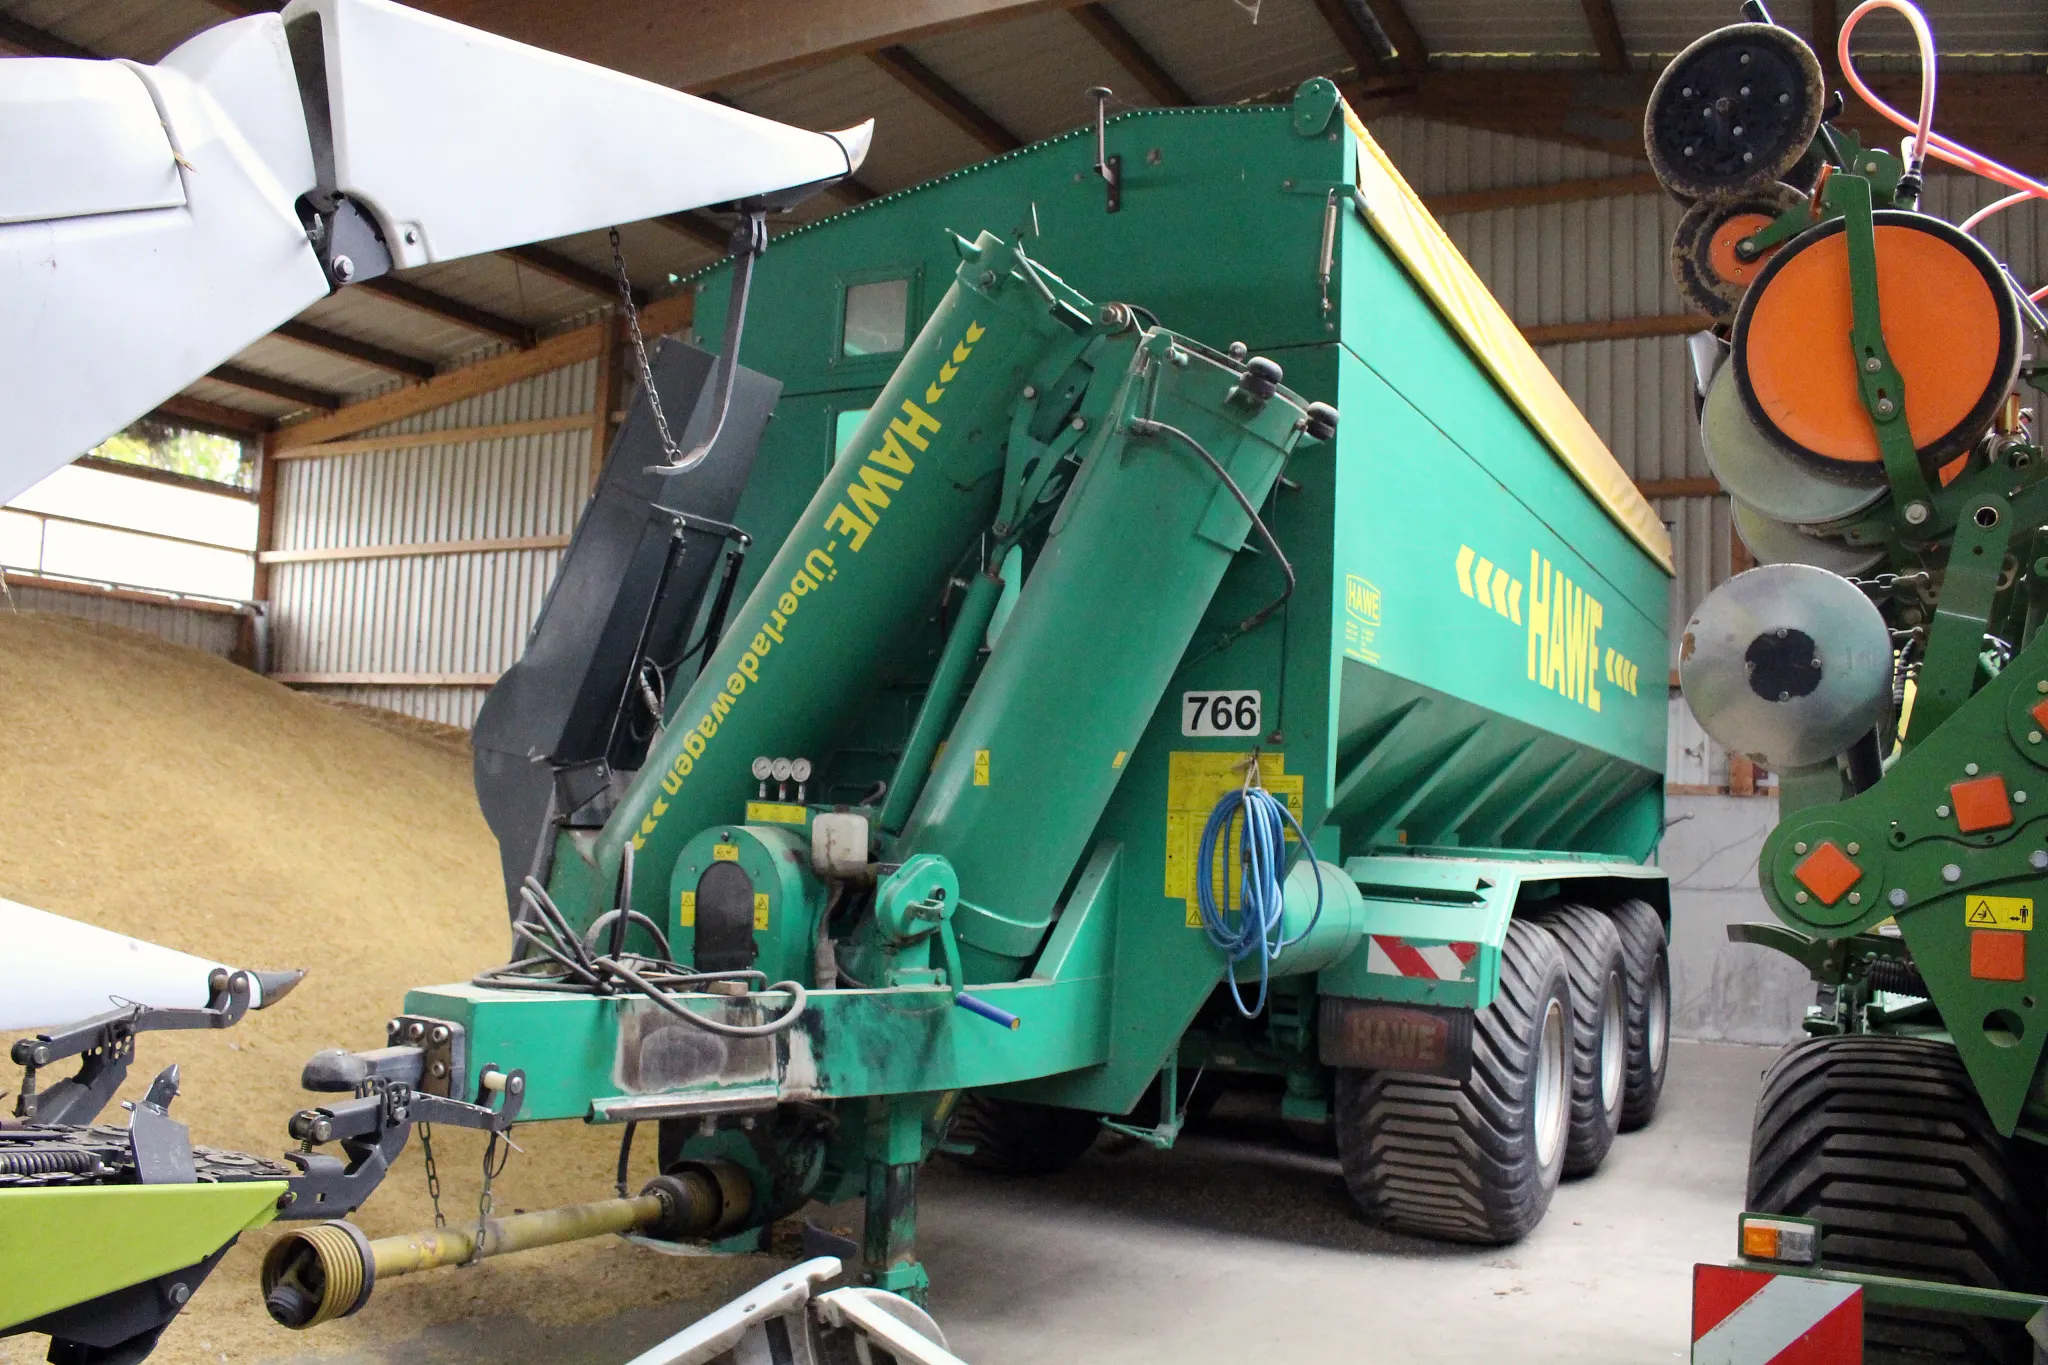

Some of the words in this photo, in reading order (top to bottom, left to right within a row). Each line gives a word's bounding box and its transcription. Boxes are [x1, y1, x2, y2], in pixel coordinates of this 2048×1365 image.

[1348, 579, 1380, 621] HAWE
[1528, 548, 1603, 713] HAWE
[1187, 696, 1257, 731] 766
[1351, 1016, 1436, 1061] HAWE
